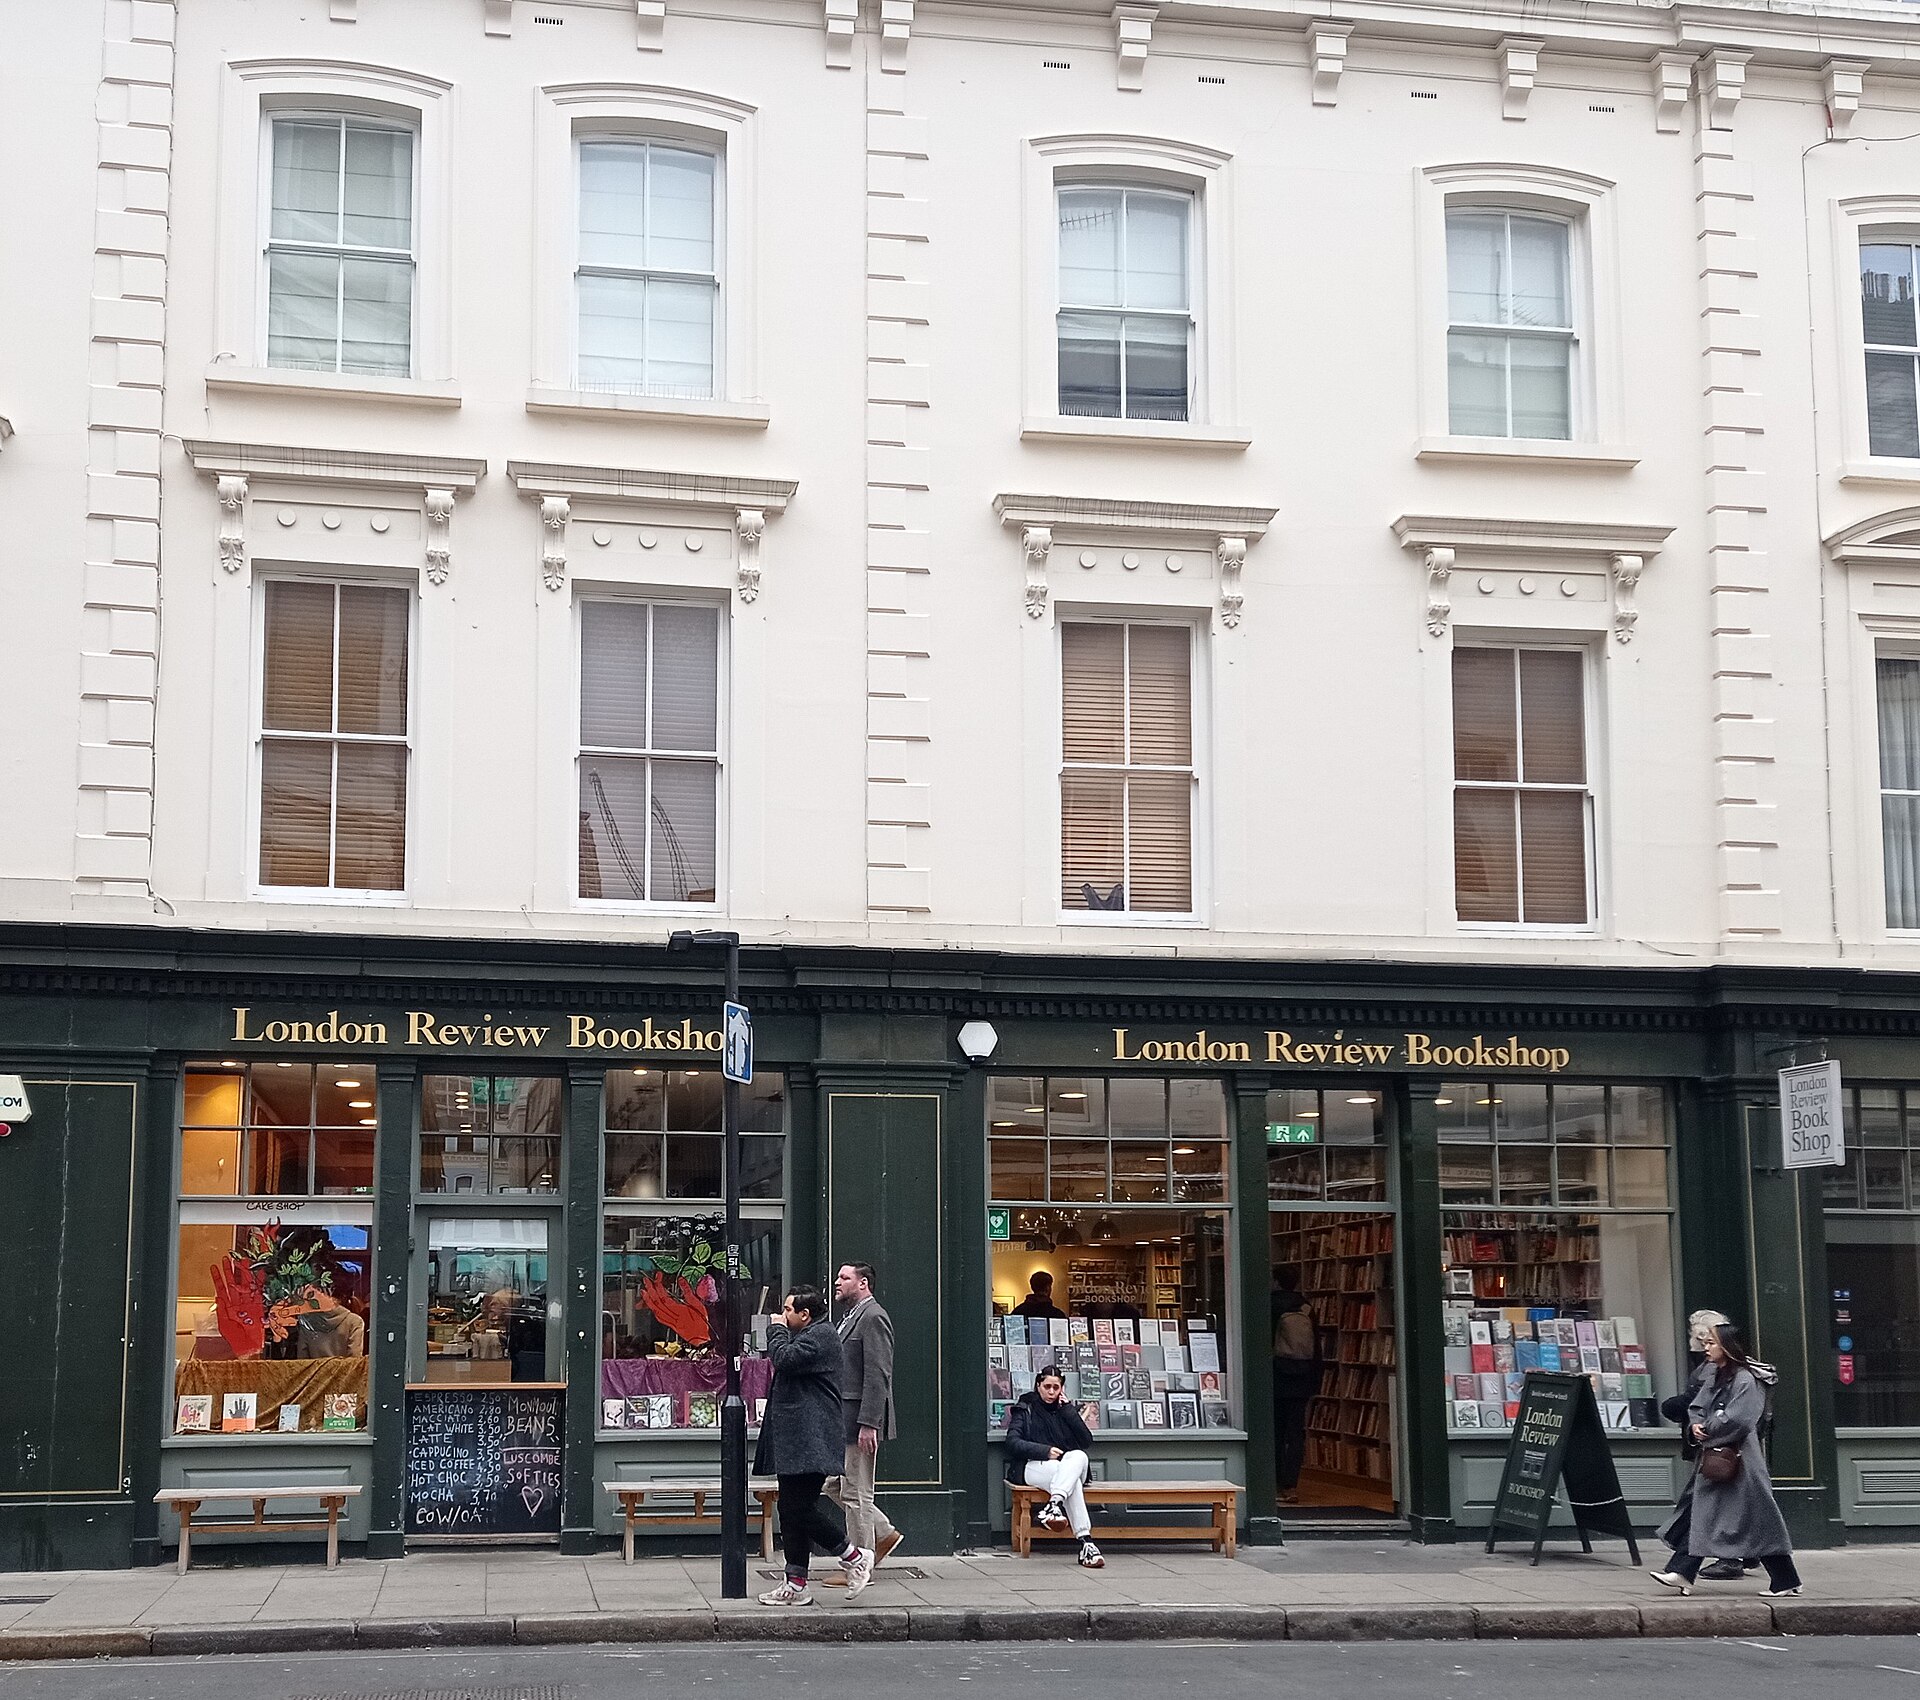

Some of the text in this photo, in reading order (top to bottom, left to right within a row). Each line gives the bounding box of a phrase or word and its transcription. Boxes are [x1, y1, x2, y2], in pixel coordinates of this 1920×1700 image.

[231, 1007, 726, 1052] London Review Booksho
[1112, 1028, 1570, 1072] London Review Bookshop
[1789, 1076, 1828, 1093] London
[1790, 1093, 1828, 1109] Review
[1791, 1107, 1829, 1130] Book
[1792, 1130, 1831, 1155] Shop
[1084, 1295, 1136, 1303] BOOKSHOP
[414, 1392, 473, 1404] ESPRESSO
[413, 1403, 474, 1414] AMERICANO
[412, 1414, 467, 1424] MACCIATO
[1524, 1406, 1563, 1428] London
[413, 1423, 442, 1433] FLAT
[444, 1423, 474, 1434] WHITE
[504, 1415, 555, 1436] BEANS
[412, 1433, 453, 1445] LATTE
[1520, 1425, 1560, 1446] Review
[412, 1445, 469, 1458] CAPPUCINO
[503, 1452, 561, 1465] LUSCOMBE
[411, 1460, 435, 1471] ICED
[439, 1458, 475, 1469] COFFEE
[410, 1473, 434, 1487] HOT
[438, 1471, 467, 1487] CHOC
[507, 1467, 561, 1489] SOFTIES
[410, 1487, 454, 1503] MOCHA
[1507, 1482, 1546, 1501] BOOKSHOP
